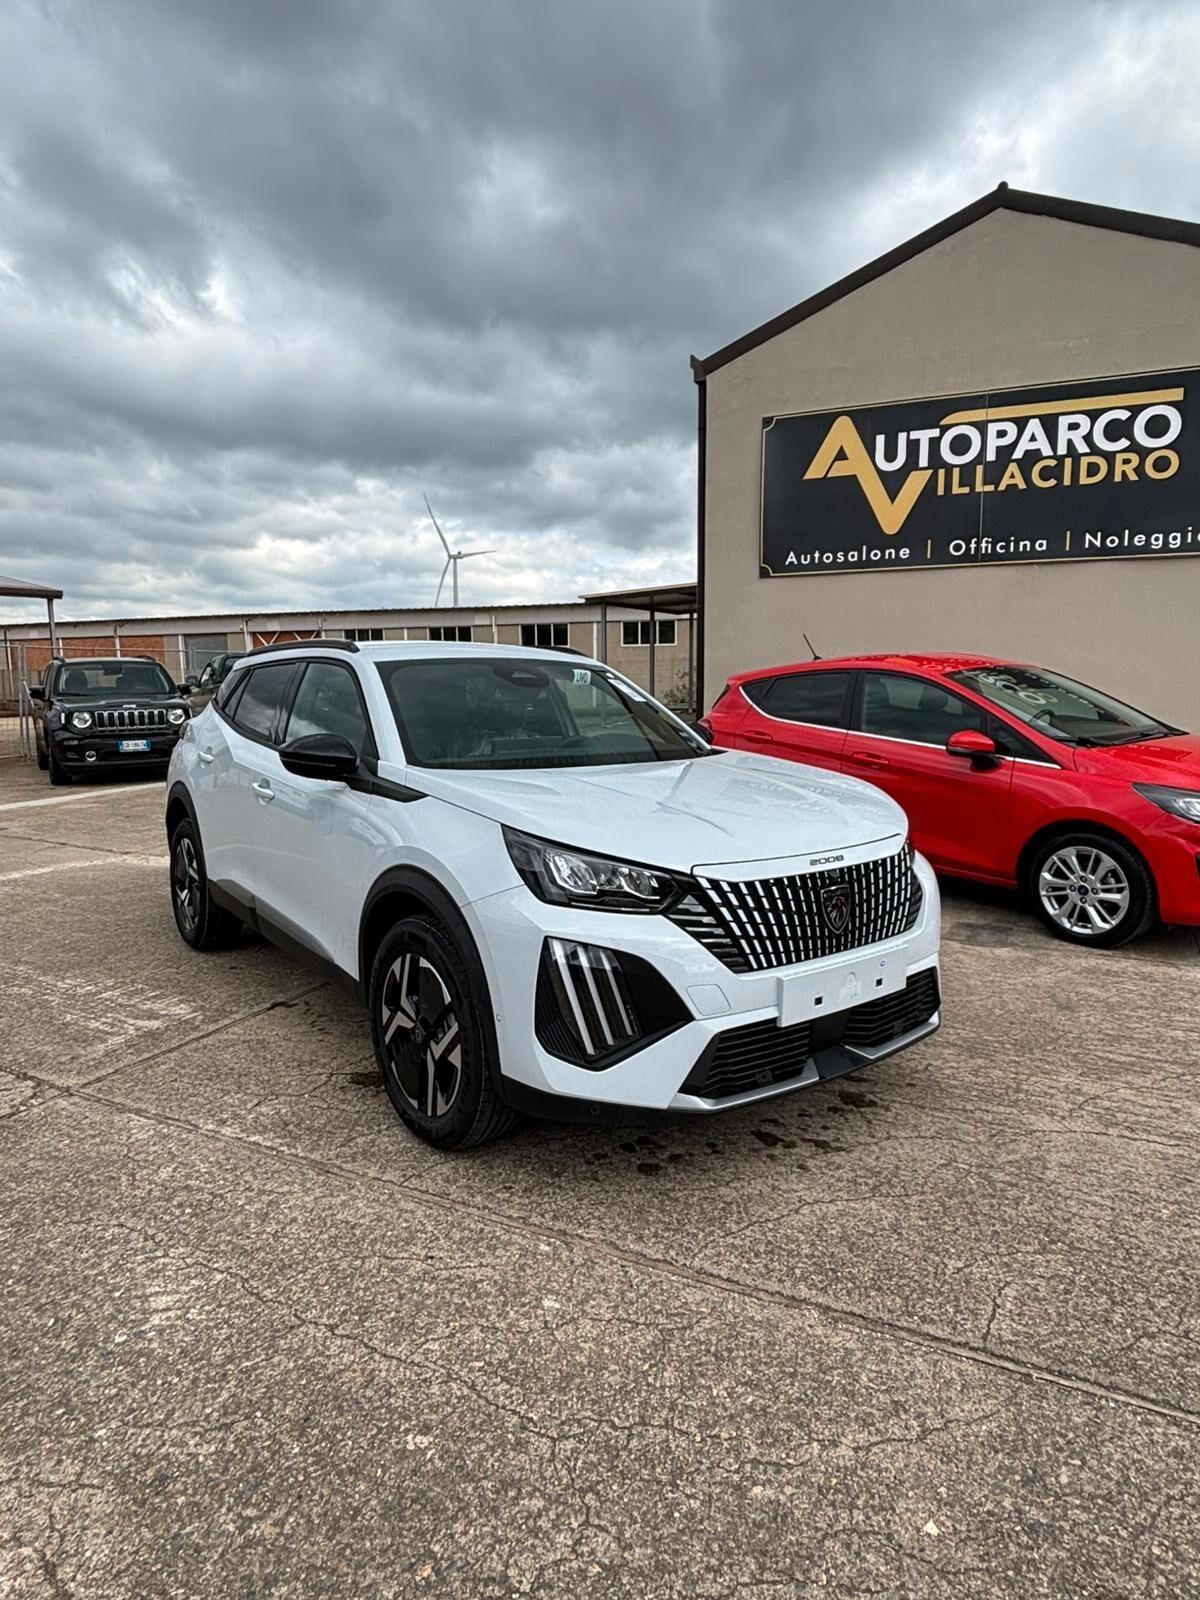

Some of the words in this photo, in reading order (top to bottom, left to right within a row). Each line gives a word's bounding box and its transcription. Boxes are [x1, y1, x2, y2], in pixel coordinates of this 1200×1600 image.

[803, 405, 1182, 480] AUTOPARCO
[855, 449, 1180, 535] VILLACIDRO
[785, 545, 910, 565] Autosalone
[949, 537, 1047, 556] Officina
[1084, 526, 1200, 549] Noleggi
[809, 854, 844, 866] 2008
